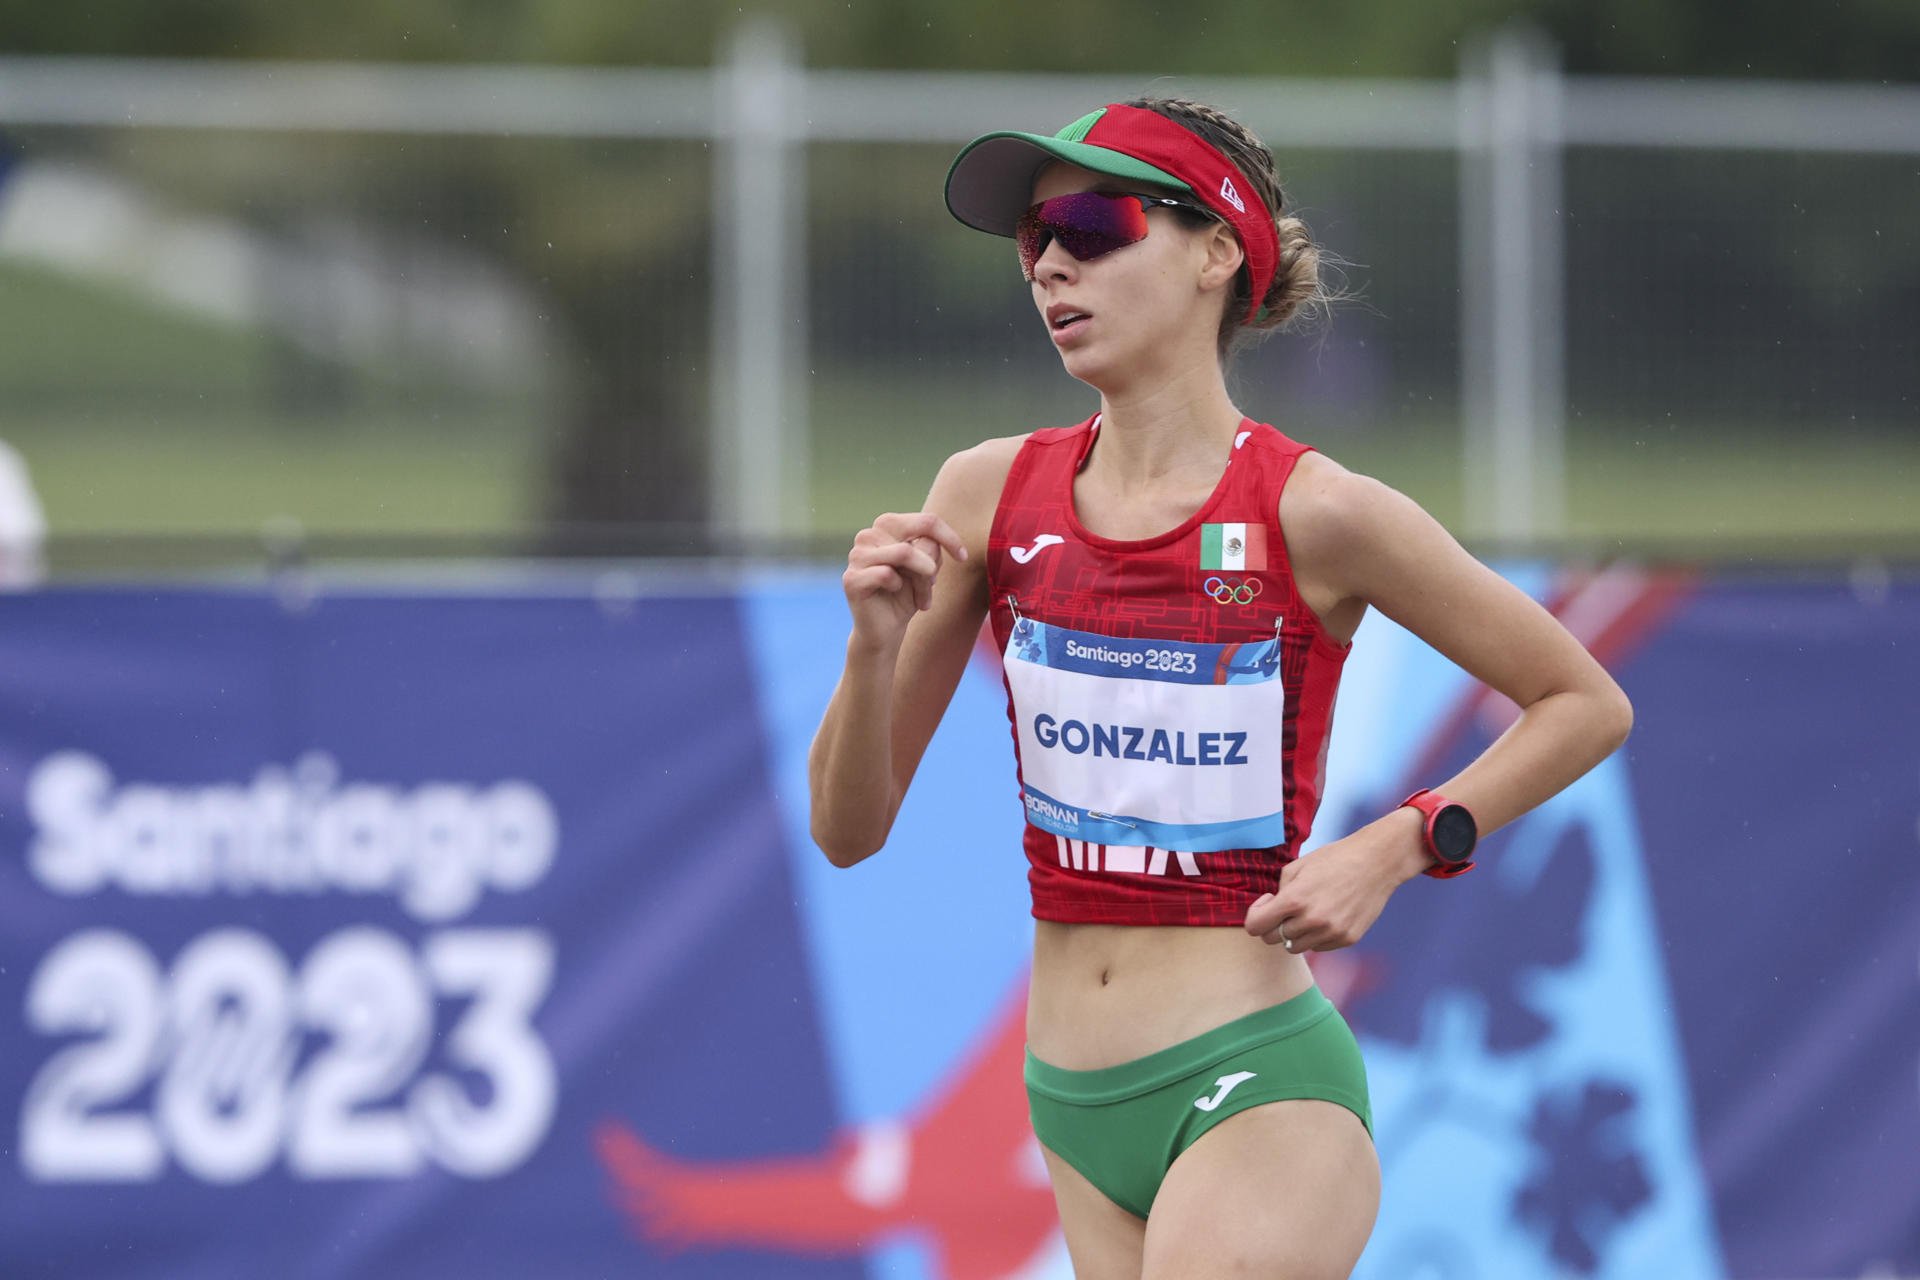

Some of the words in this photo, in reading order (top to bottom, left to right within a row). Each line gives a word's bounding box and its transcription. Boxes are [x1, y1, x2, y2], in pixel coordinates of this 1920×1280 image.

[1066, 640, 1144, 668] Santiago
[1145, 649, 1197, 675] 2023
[1034, 713, 1248, 766] GONZALEZ
[1024, 793, 1079, 825] BORNAN
[28, 751, 559, 921] Santiago
[21, 928, 557, 1183] 2023
